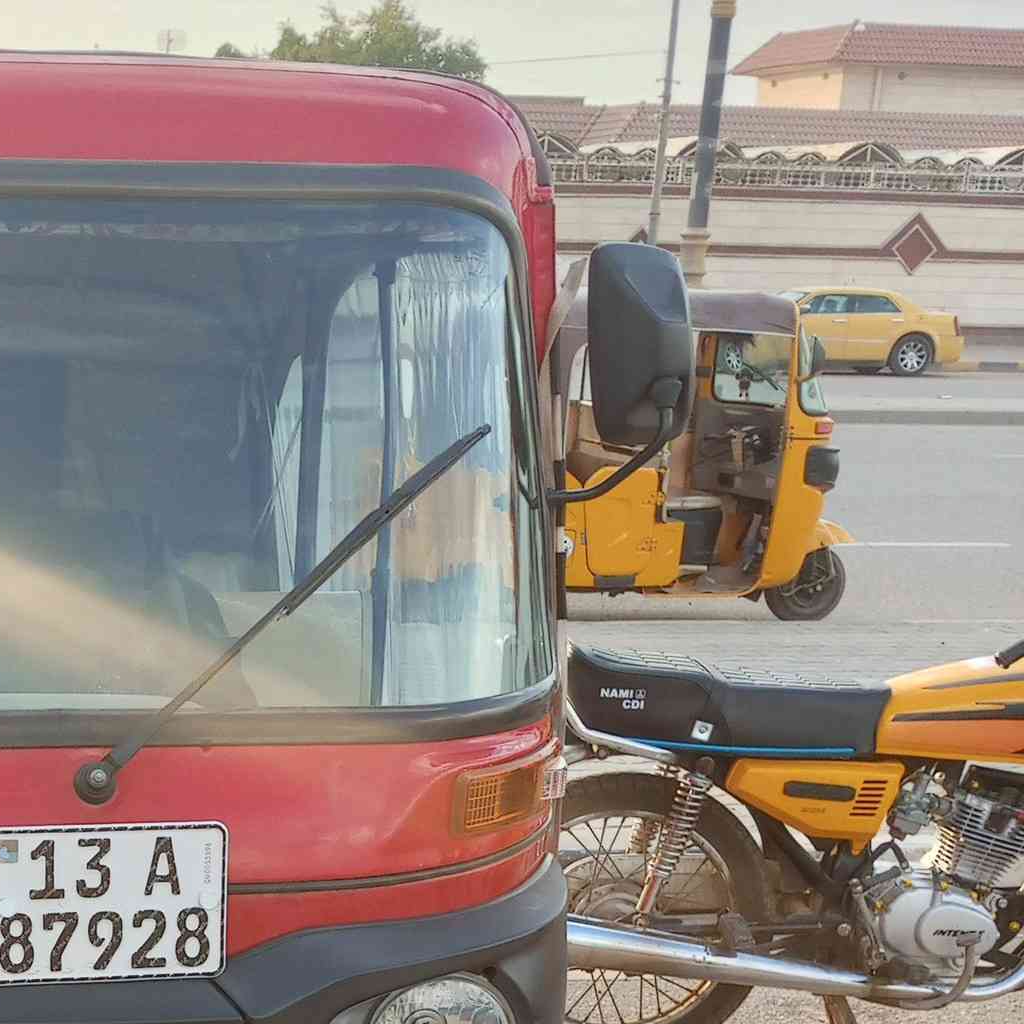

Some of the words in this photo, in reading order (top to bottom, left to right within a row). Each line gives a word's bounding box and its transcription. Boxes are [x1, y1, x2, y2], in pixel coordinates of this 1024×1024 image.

[600, 688, 634, 698] NAMI
[622, 699, 645, 710] CDI
[29, 838, 112, 900] 13
[144, 836, 181, 896] A
